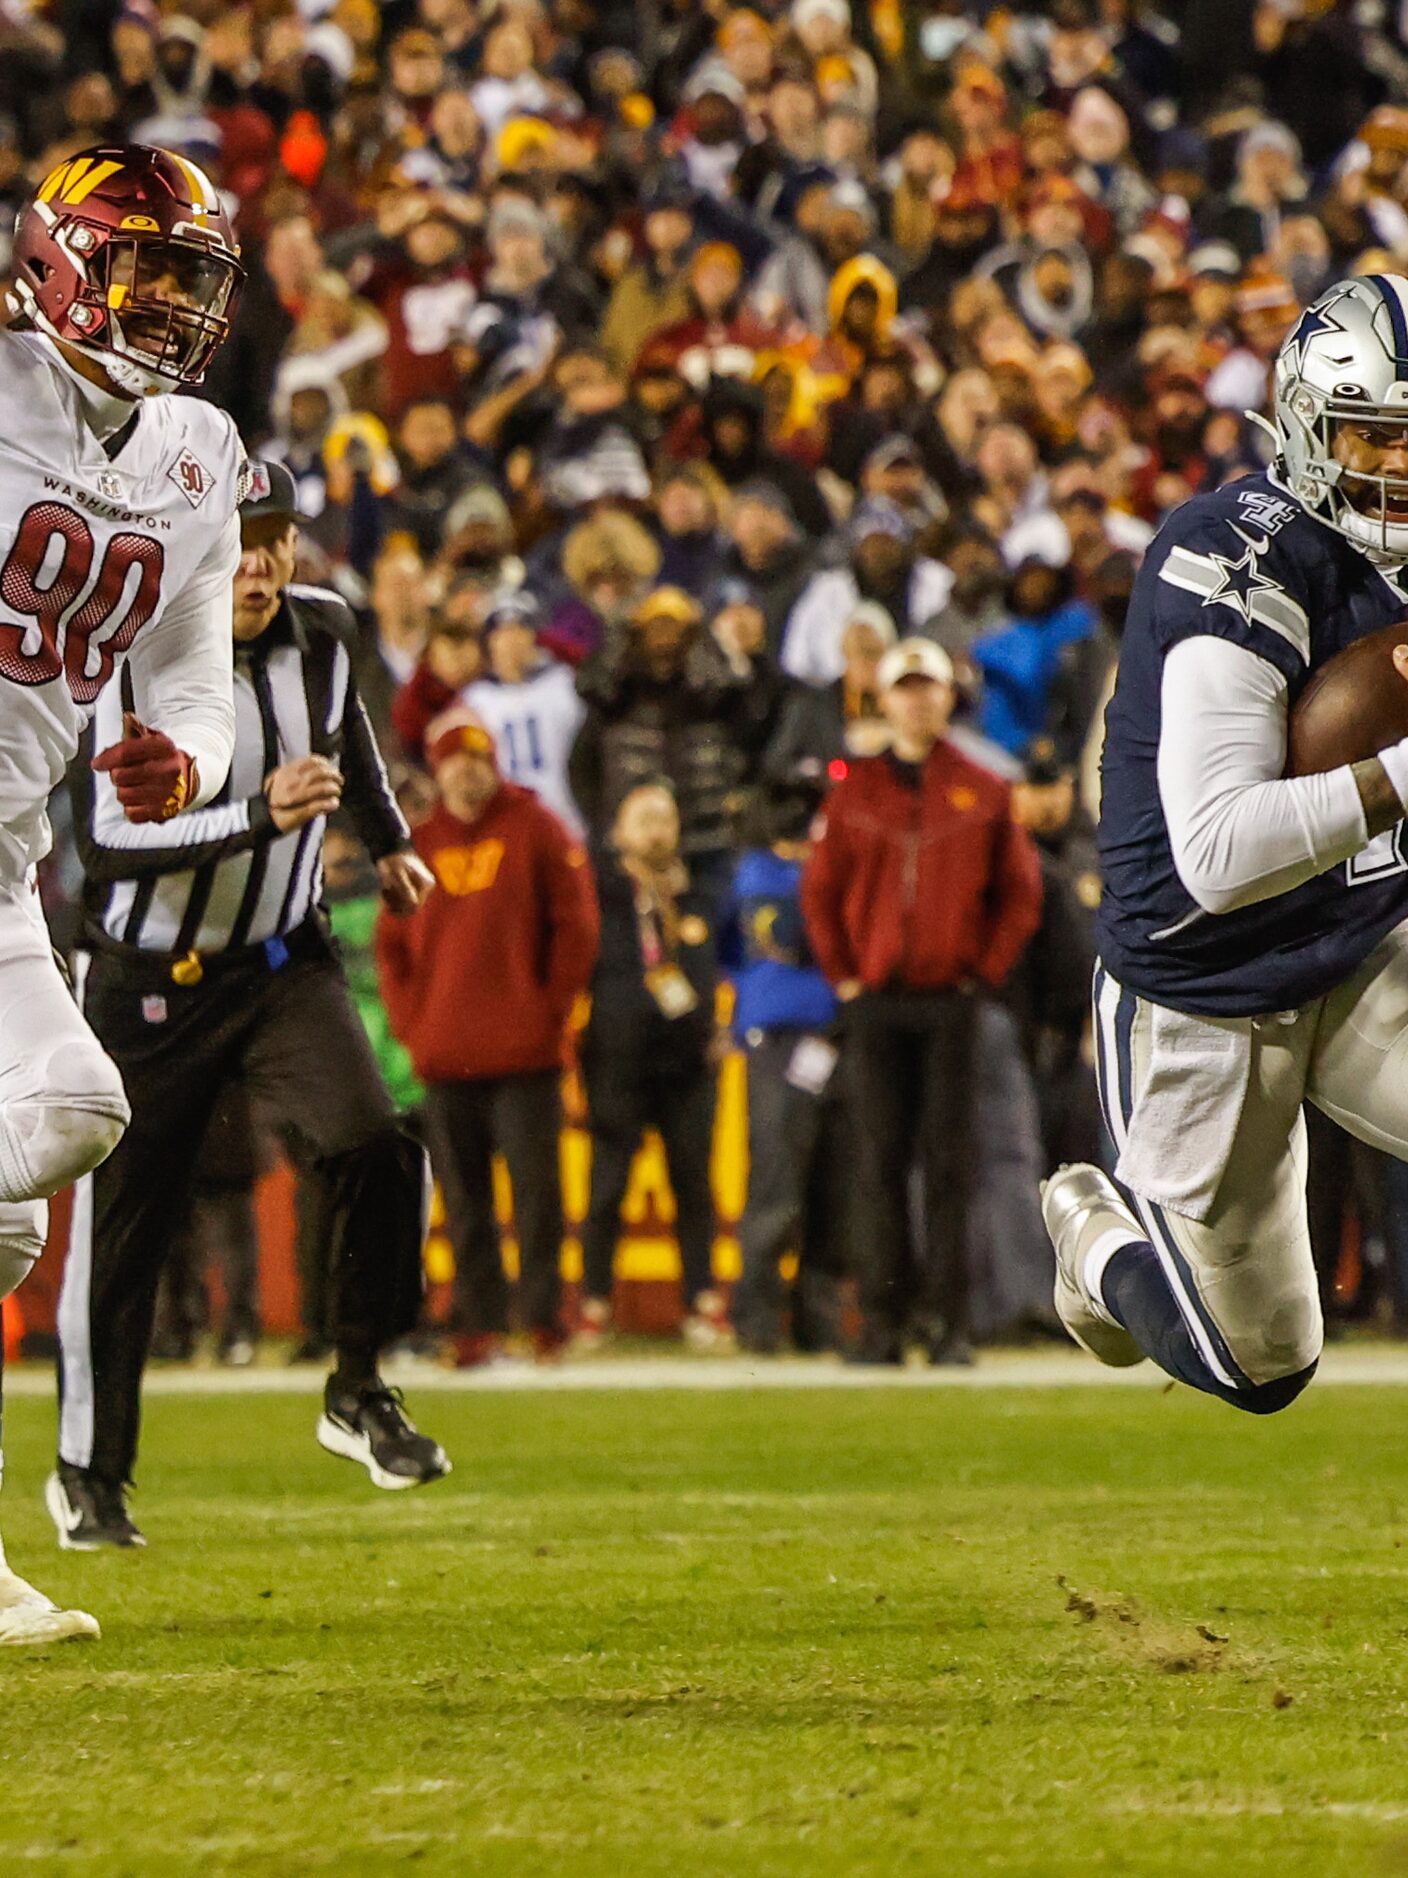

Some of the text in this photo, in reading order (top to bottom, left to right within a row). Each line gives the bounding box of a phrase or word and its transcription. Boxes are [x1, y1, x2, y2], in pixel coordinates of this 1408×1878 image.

[180, 461, 204, 494] 90
[43, 476, 172, 530] WASHINGTON
[1237, 490, 1296, 536] 4
[0, 500, 164, 704] 90
